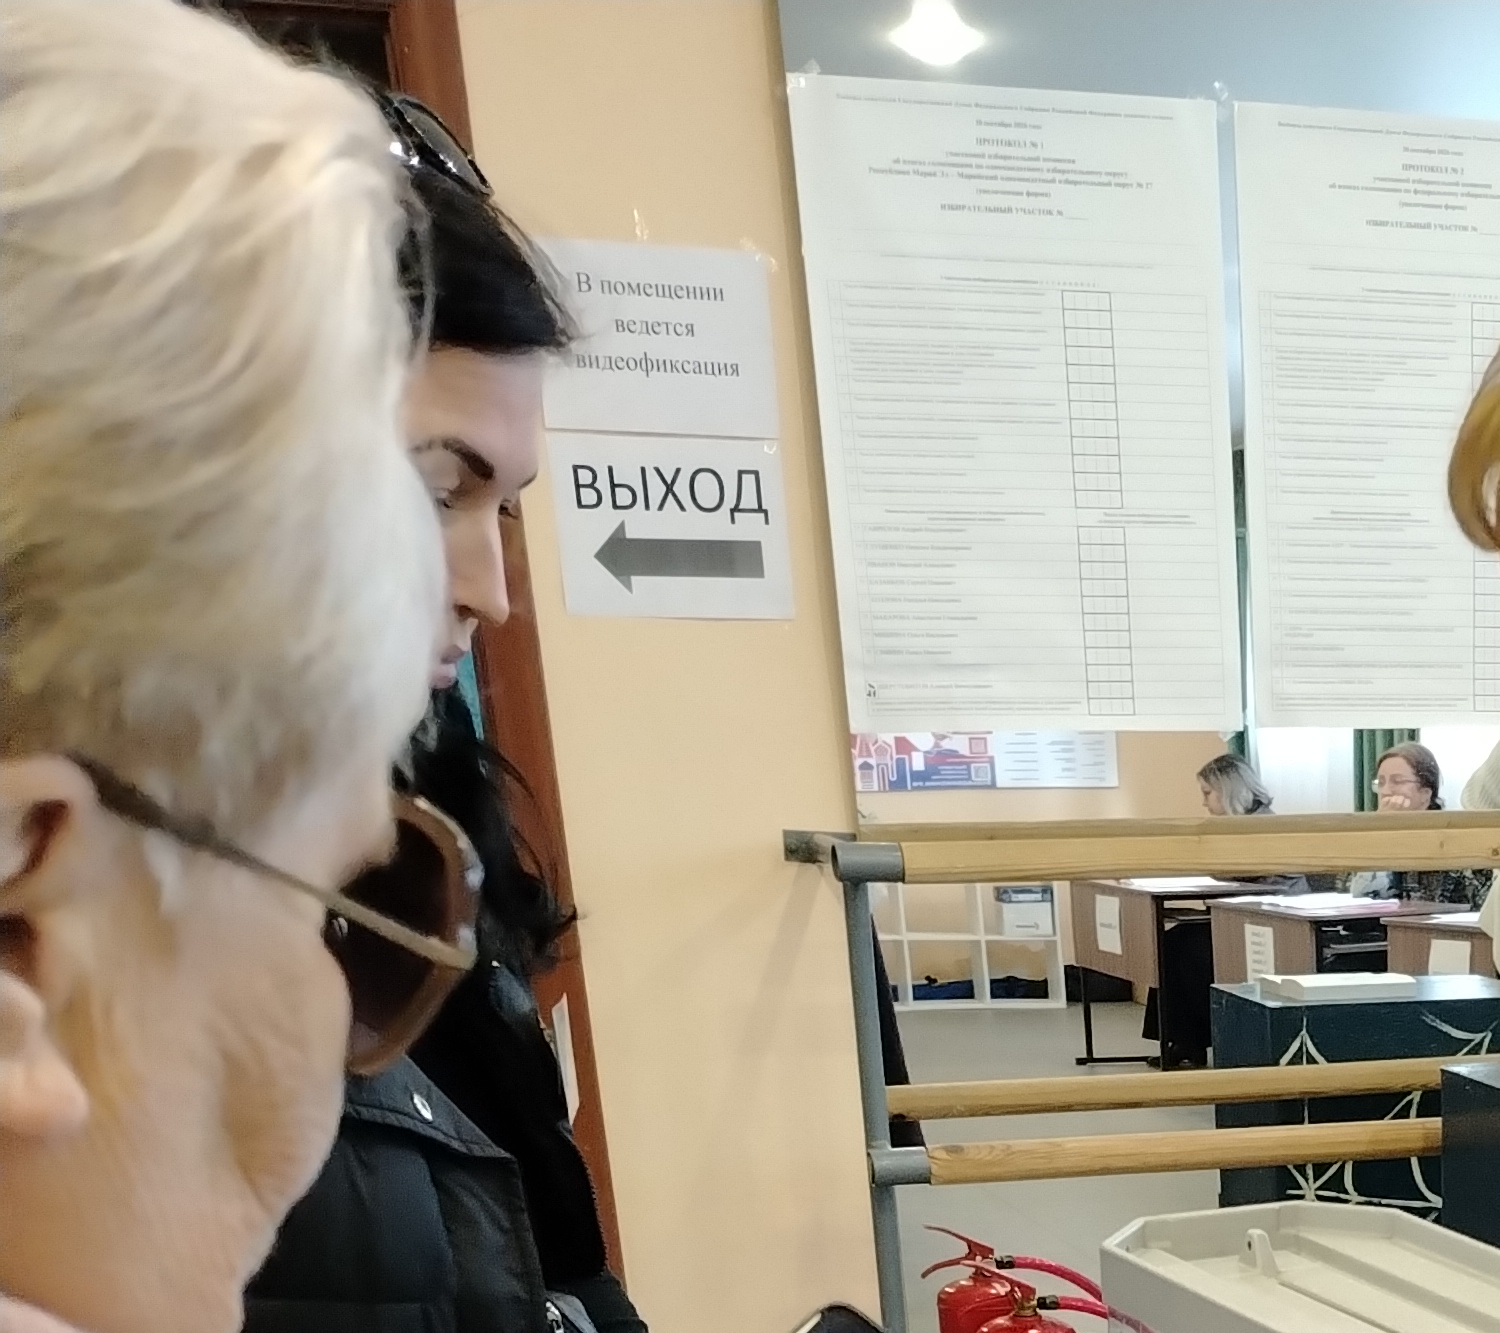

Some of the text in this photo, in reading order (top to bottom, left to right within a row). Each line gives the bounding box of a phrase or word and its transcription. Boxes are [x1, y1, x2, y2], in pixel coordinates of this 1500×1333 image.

[575, 272, 725, 302] В помещении
[614, 318, 695, 338] ведется
[575, 351, 740, 378] видеофиксация
[571, 464, 770, 525] ВЫХОД
